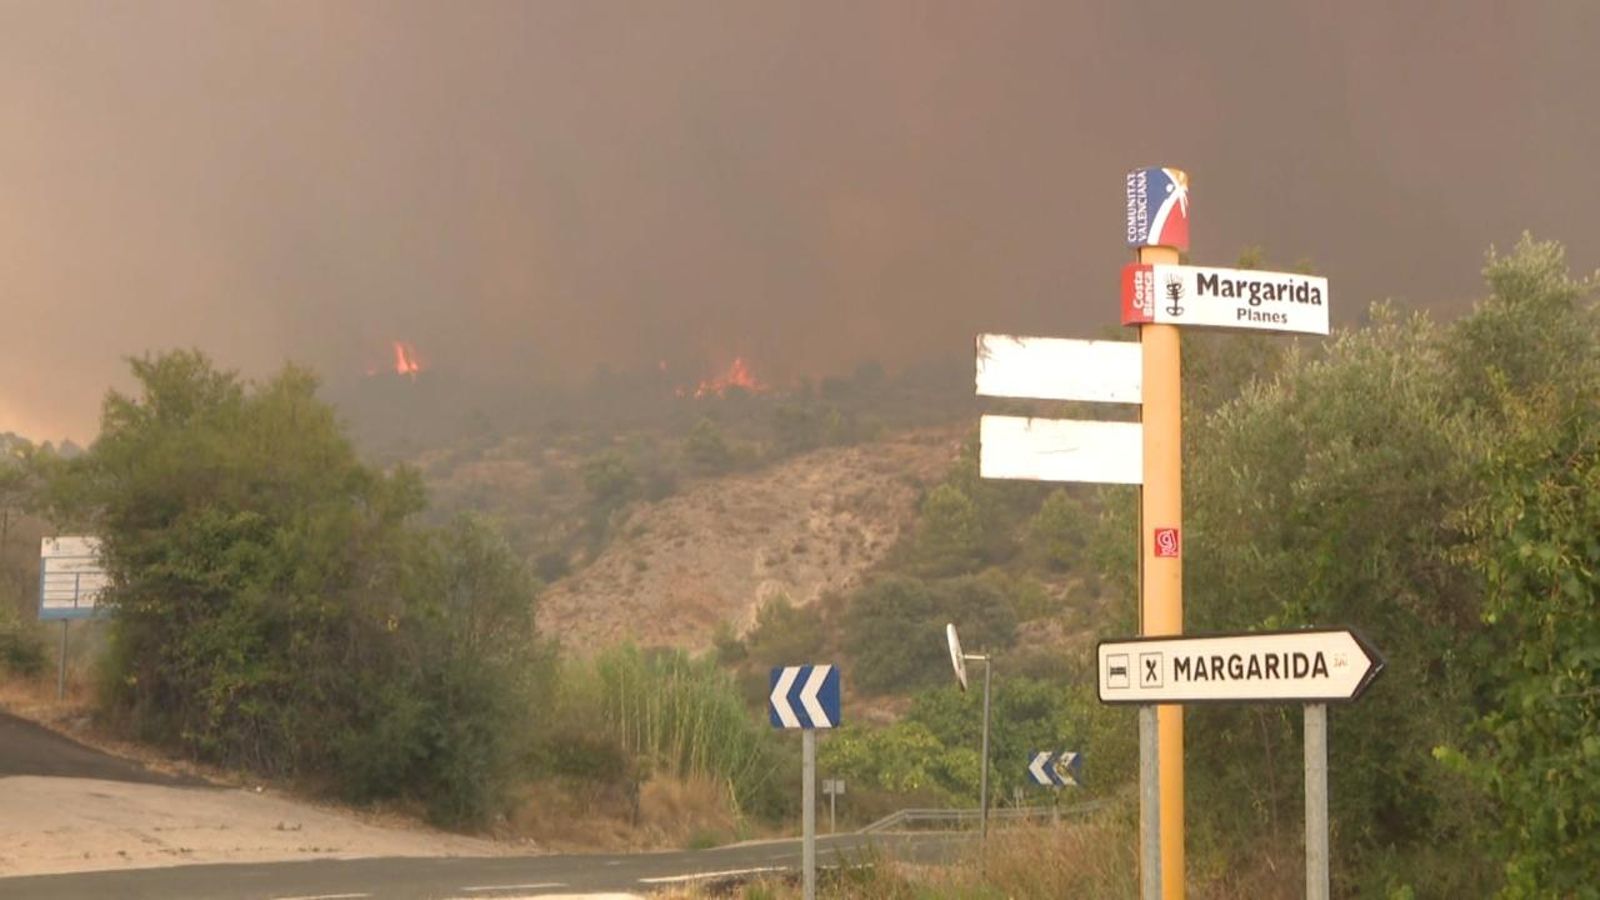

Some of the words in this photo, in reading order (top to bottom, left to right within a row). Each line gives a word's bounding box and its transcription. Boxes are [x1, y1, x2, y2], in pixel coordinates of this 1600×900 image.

[1127, 173, 1137, 242] COMUNITAT
[1137, 171, 1147, 242] VALENCIANA
[1133, 270, 1143, 309] Costa
[1143, 271, 1153, 317] Blanca
[1196, 272, 1322, 306] Margarida
[1236, 307, 1288, 324] Planes
[1173, 651, 1330, 681] MARGARIDA
